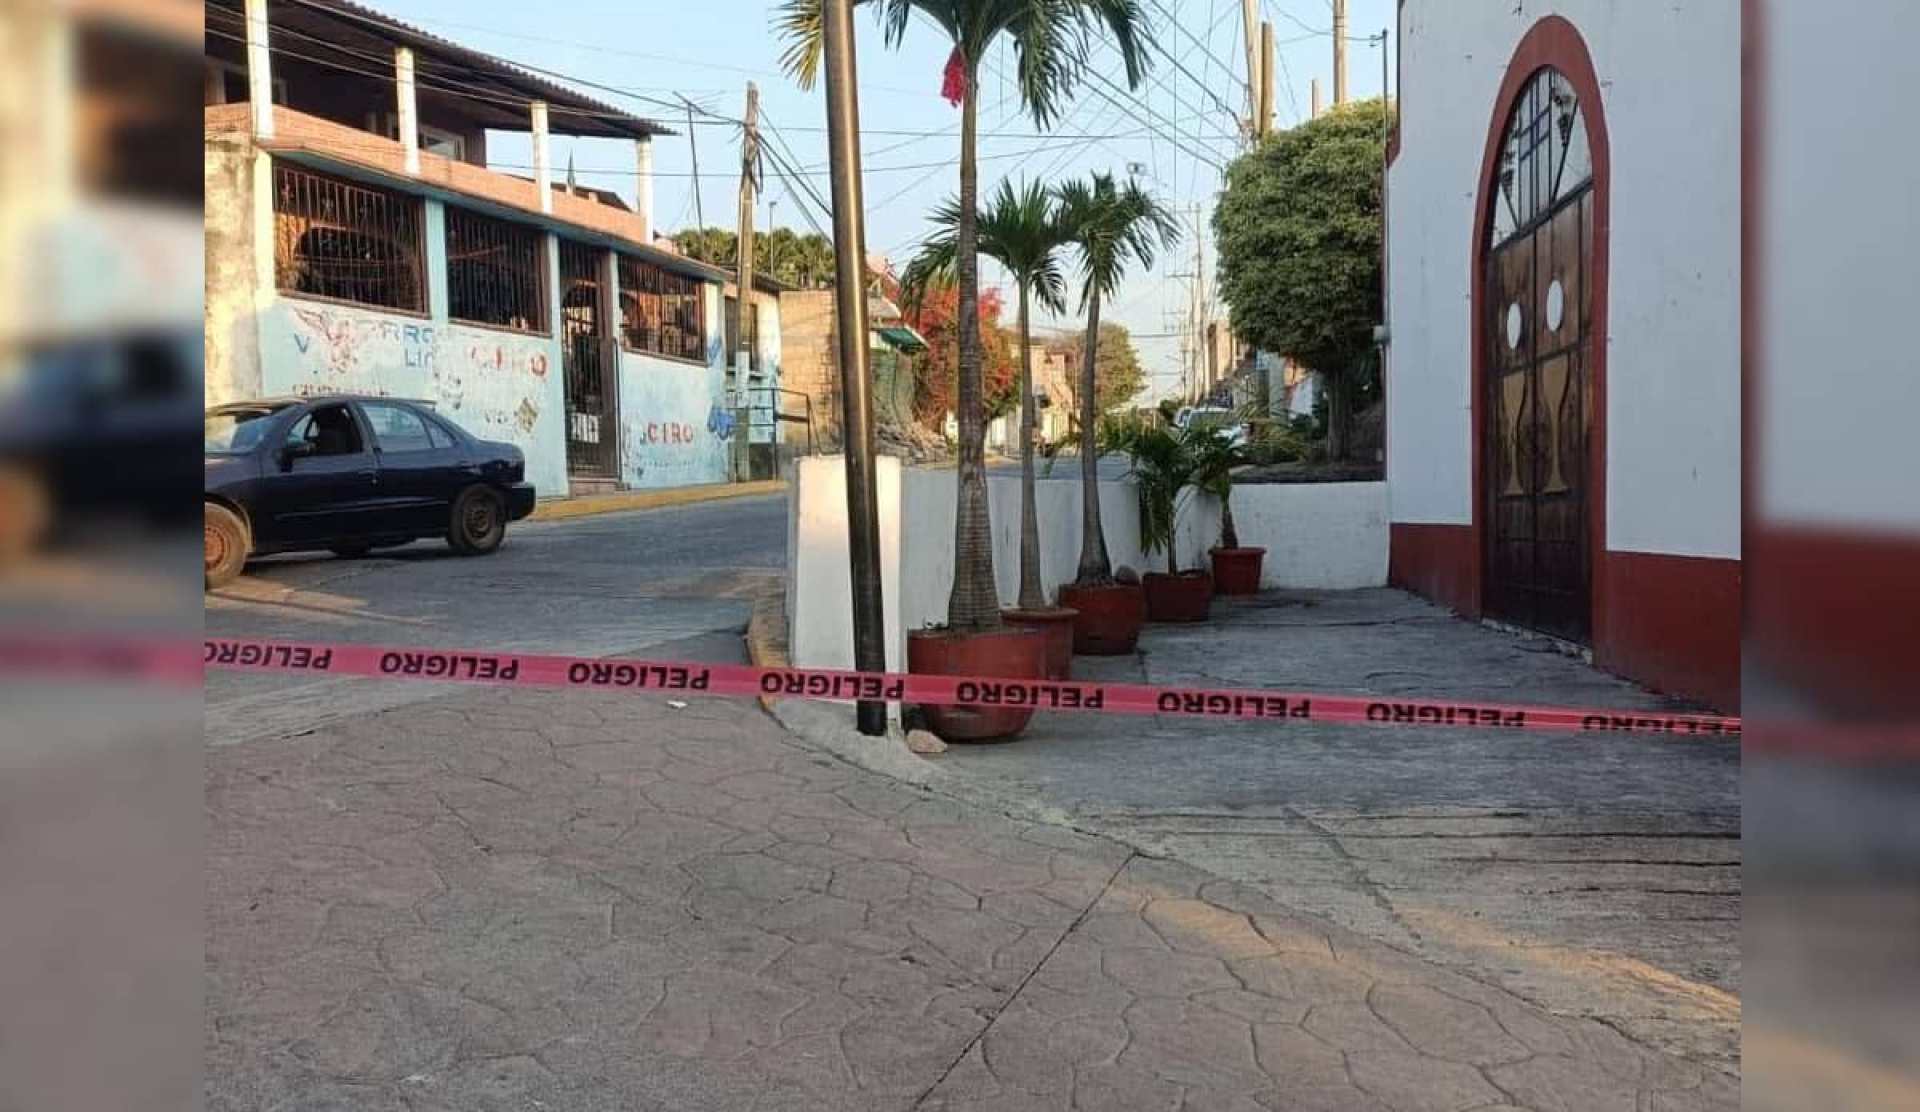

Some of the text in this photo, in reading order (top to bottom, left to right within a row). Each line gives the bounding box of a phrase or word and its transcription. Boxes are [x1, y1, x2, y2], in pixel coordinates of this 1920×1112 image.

[647, 421, 694, 445] CIRO
[380, 652, 519, 681] PELIGRO
[568, 662, 710, 690] PELIGRO
[760, 671, 905, 700] PELIGRO
[956, 681, 1104, 709] PELIGRO
[1157, 691, 1311, 719] PELIGRO
[1366, 703, 1525, 727] PELIGRO
